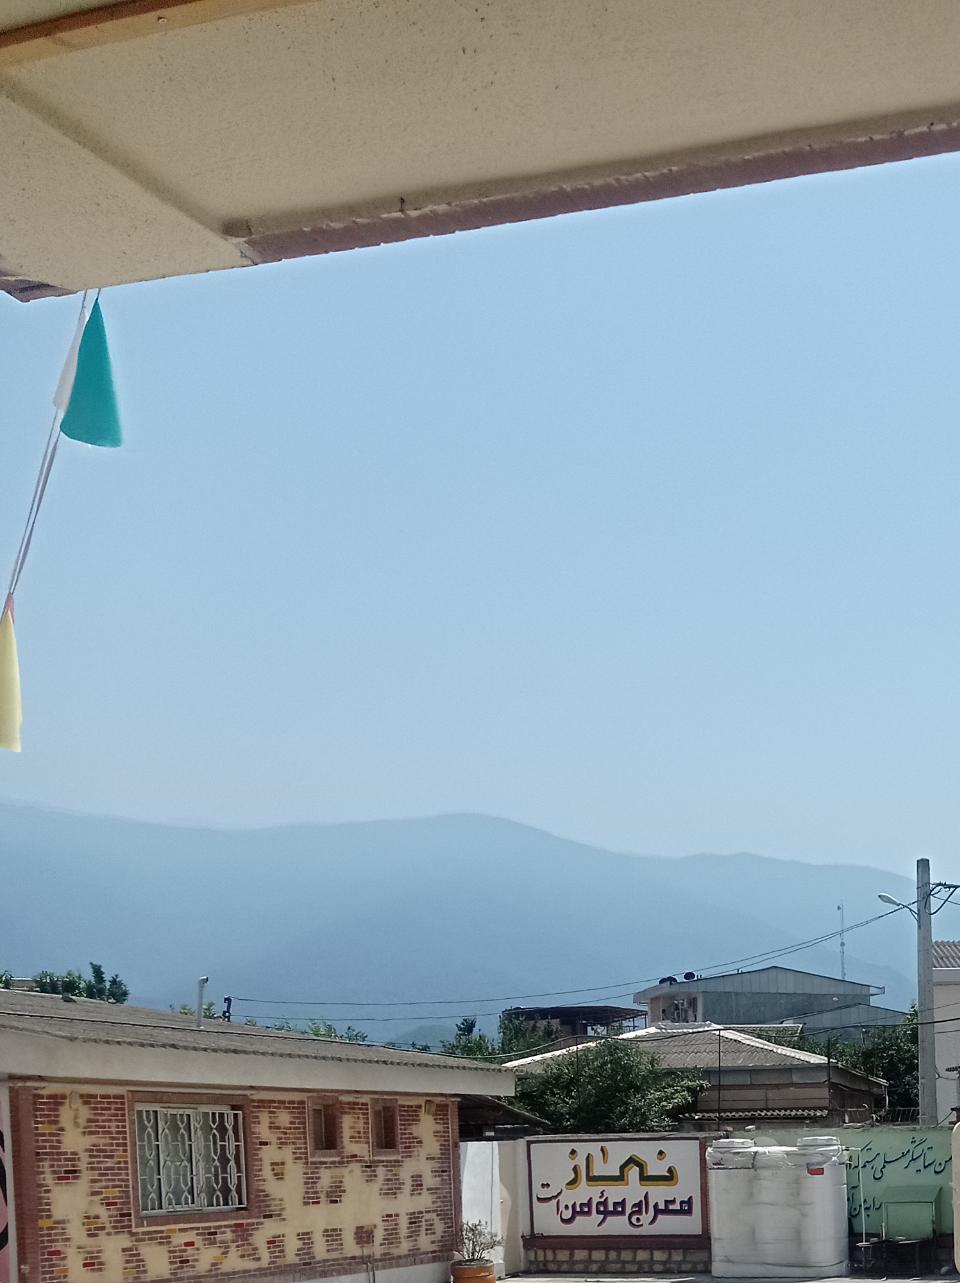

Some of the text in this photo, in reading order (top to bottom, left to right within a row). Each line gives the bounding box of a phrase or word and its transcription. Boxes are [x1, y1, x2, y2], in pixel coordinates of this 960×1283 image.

[565, 1145, 679, 1190] نماز
[873, 1149, 910, 1180] معلمی
[536, 1182, 693, 1229] معراج مؤمن است
